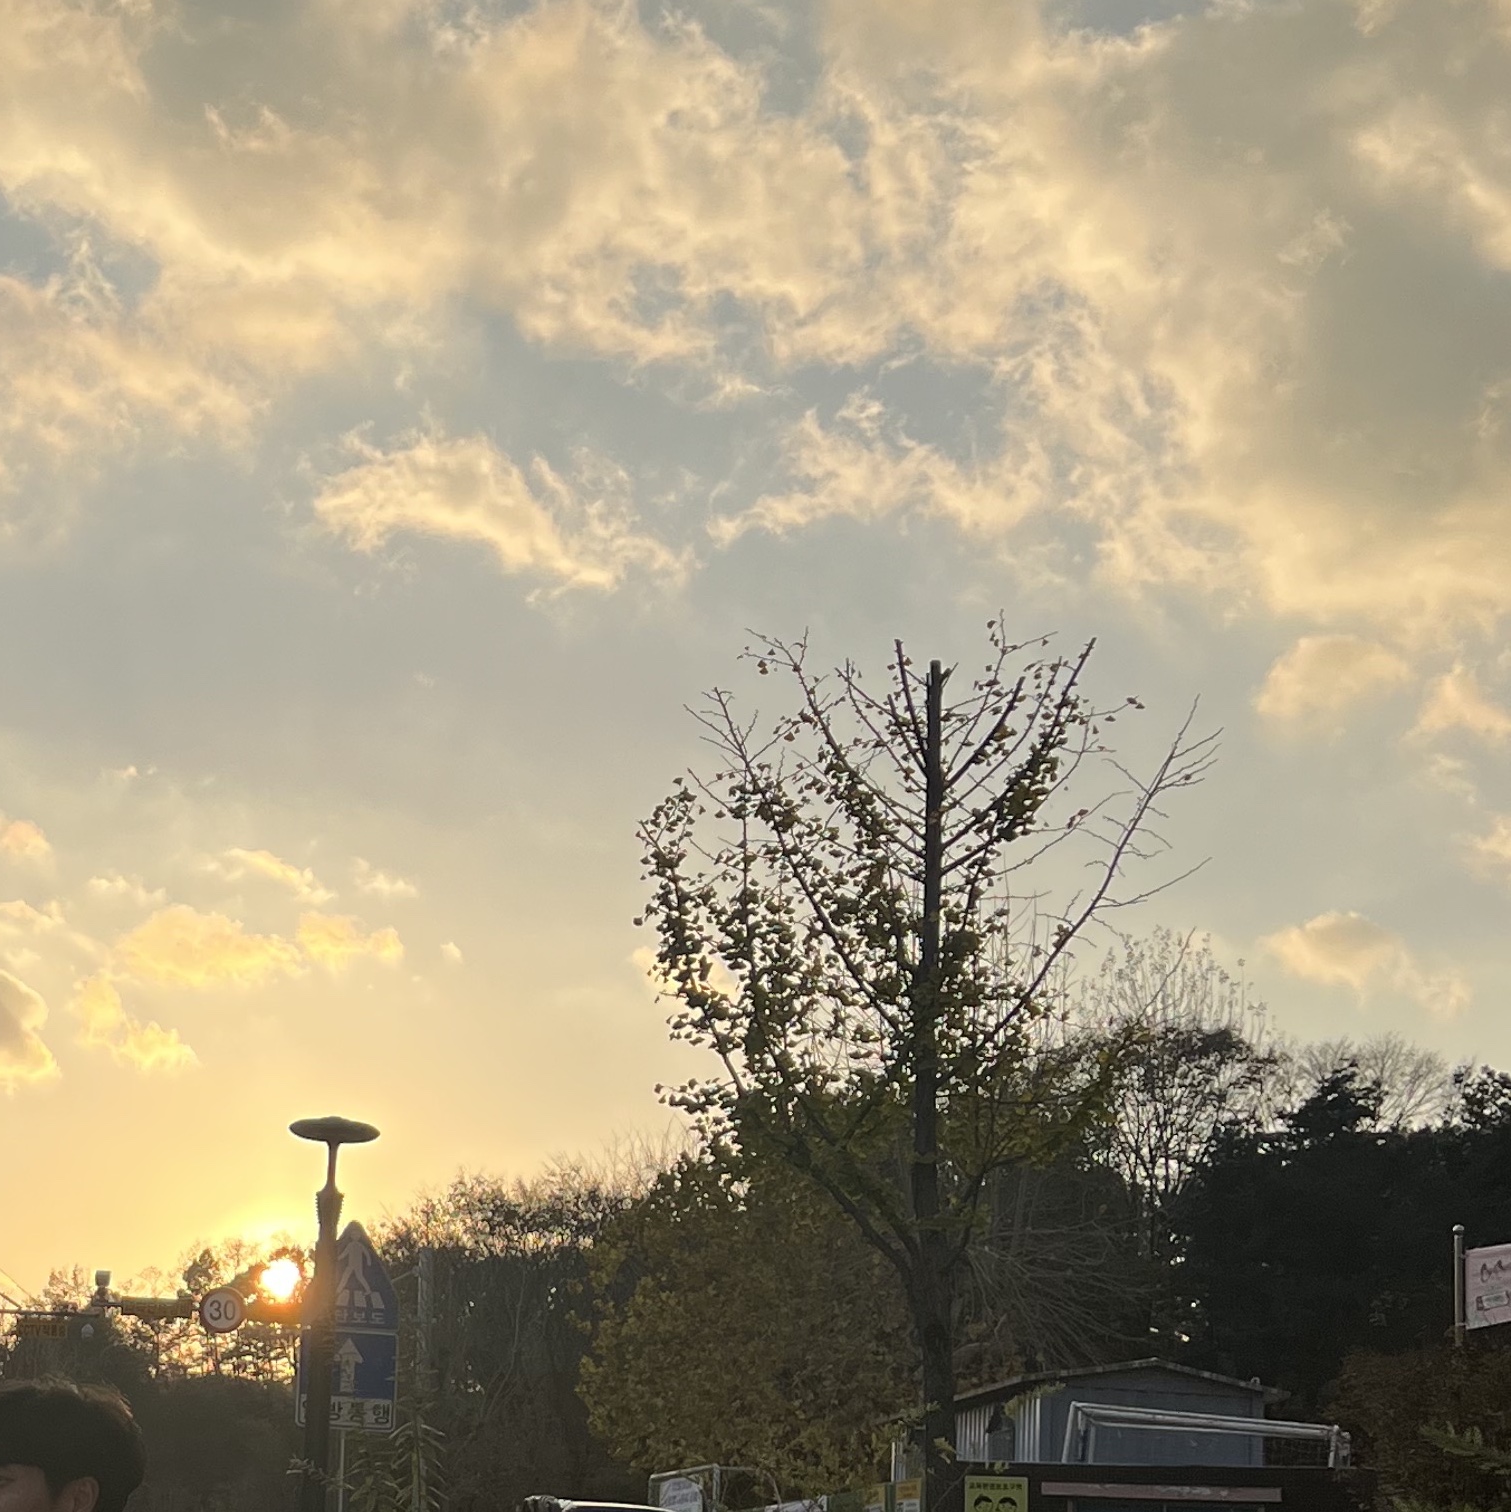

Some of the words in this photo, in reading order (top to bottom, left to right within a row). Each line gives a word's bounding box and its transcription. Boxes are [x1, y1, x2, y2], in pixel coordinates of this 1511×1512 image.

[209, 1300, 236, 1321] 30
[335, 1310, 385, 1324] 단보도
[302, 1401, 390, 1425] 방통행
